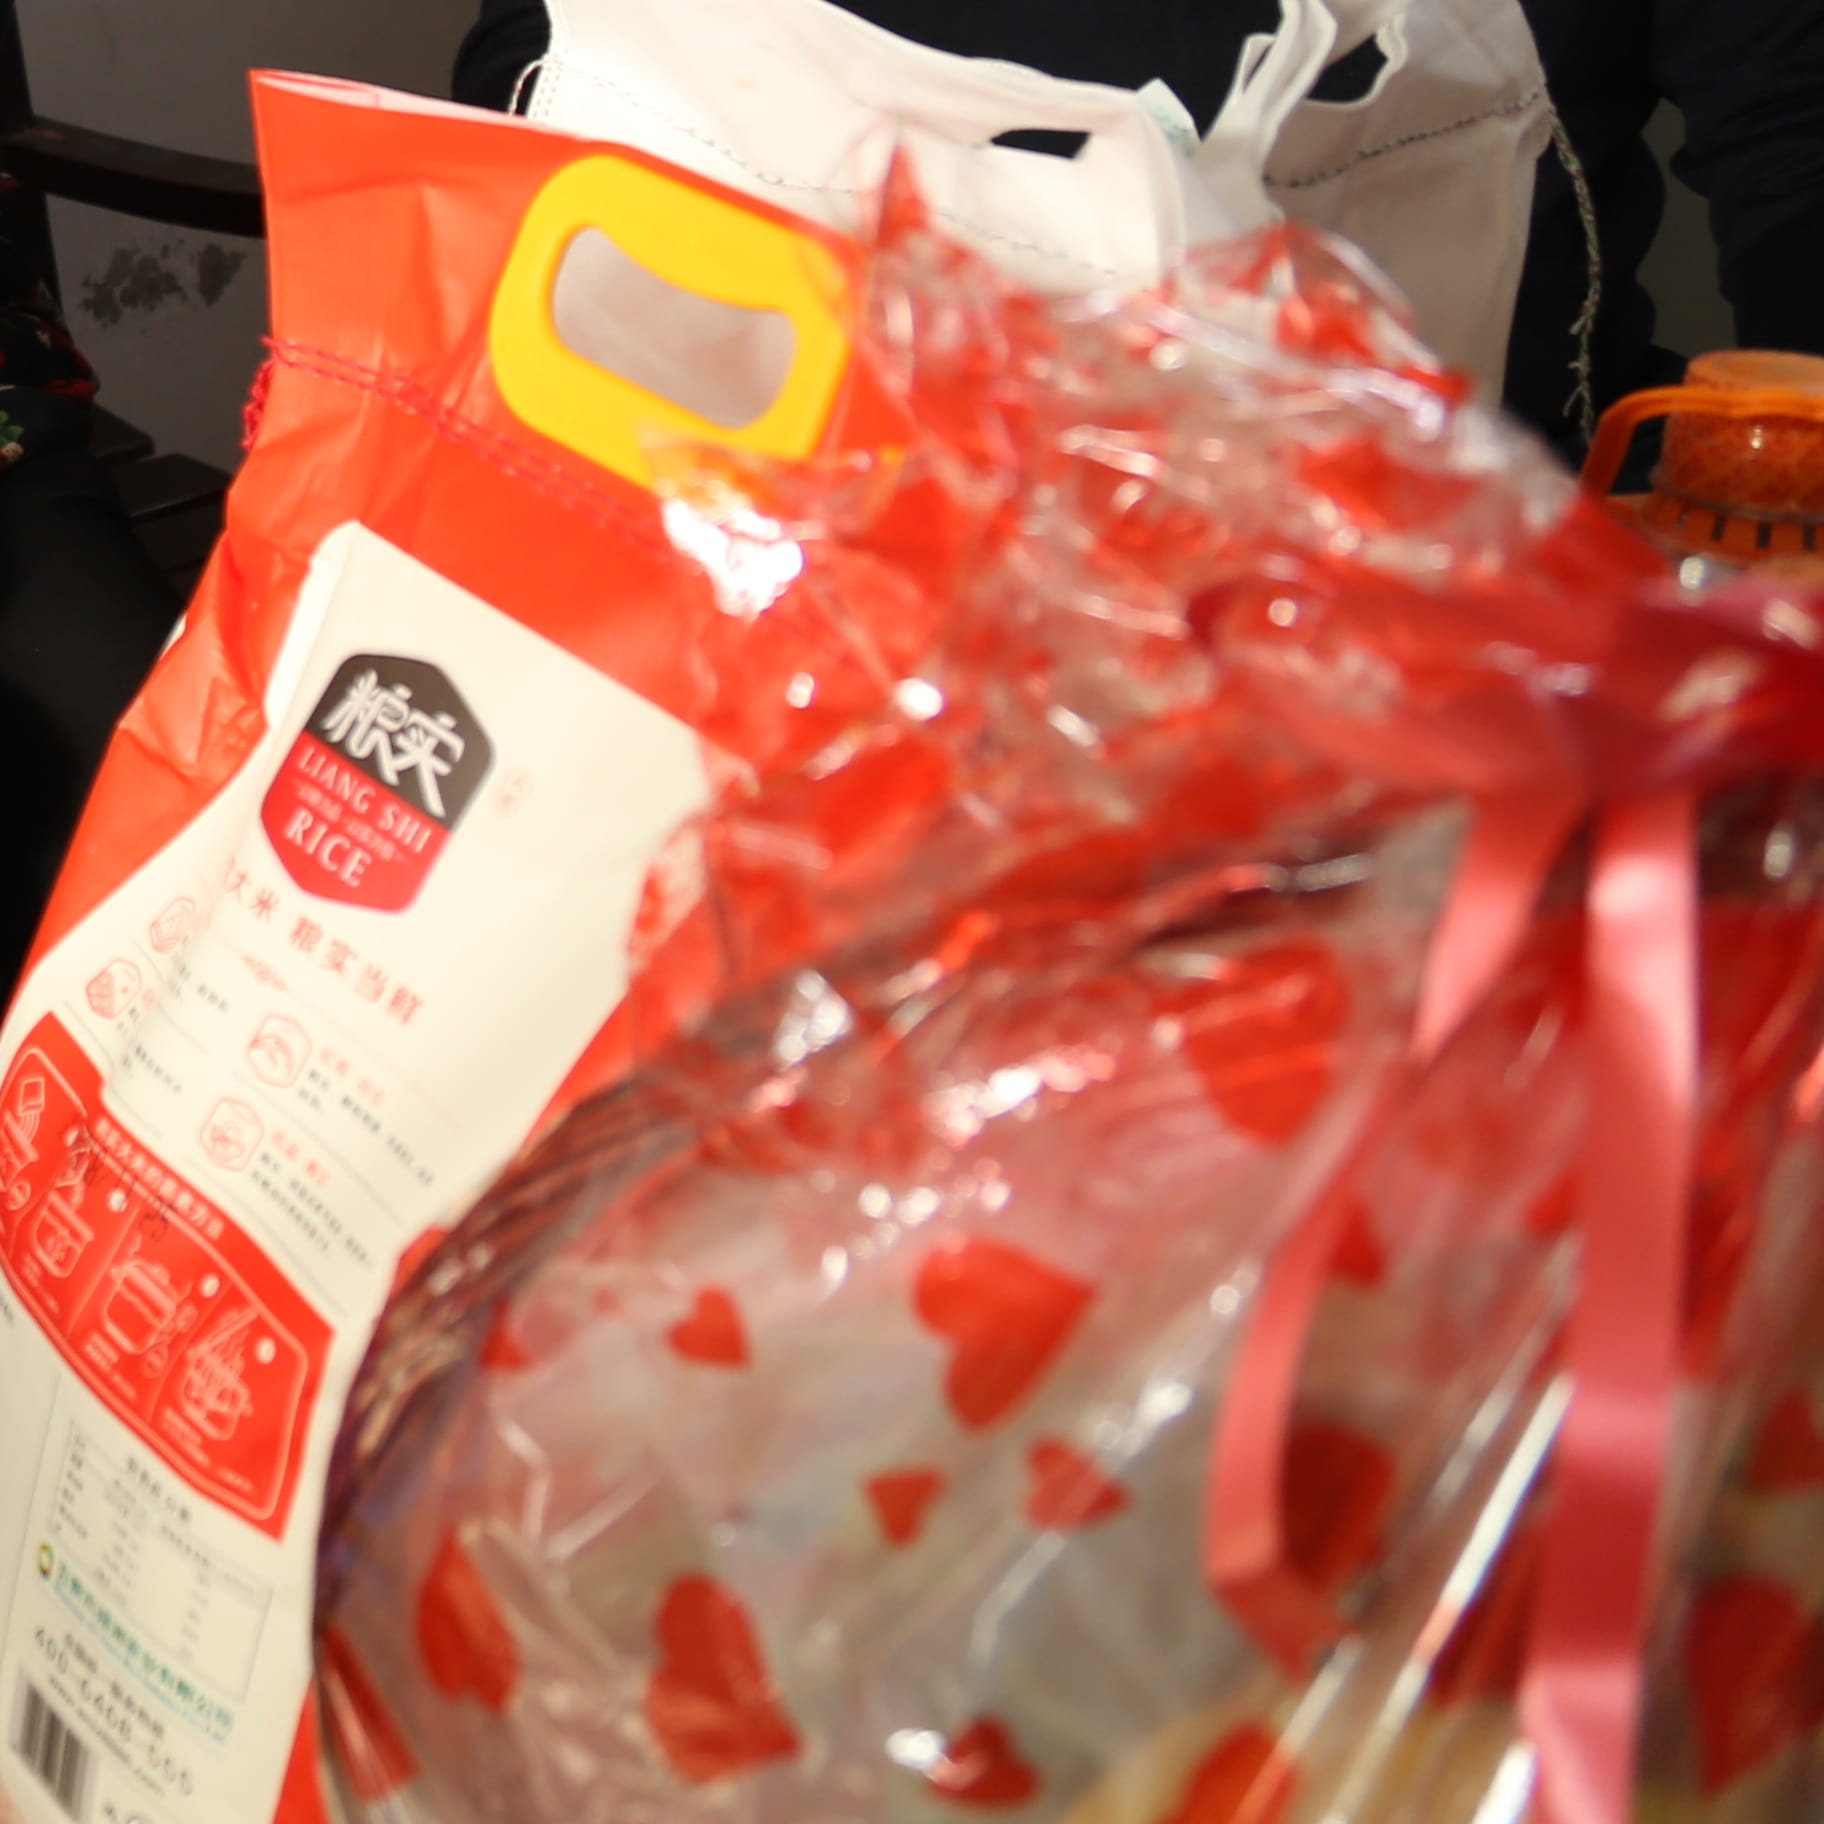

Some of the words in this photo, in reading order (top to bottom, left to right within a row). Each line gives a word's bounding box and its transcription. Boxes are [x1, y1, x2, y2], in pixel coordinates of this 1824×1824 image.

[284, 805, 374, 889] RICE
[296, 745, 377, 815] LIANG
[381, 803, 433, 856] SHI
